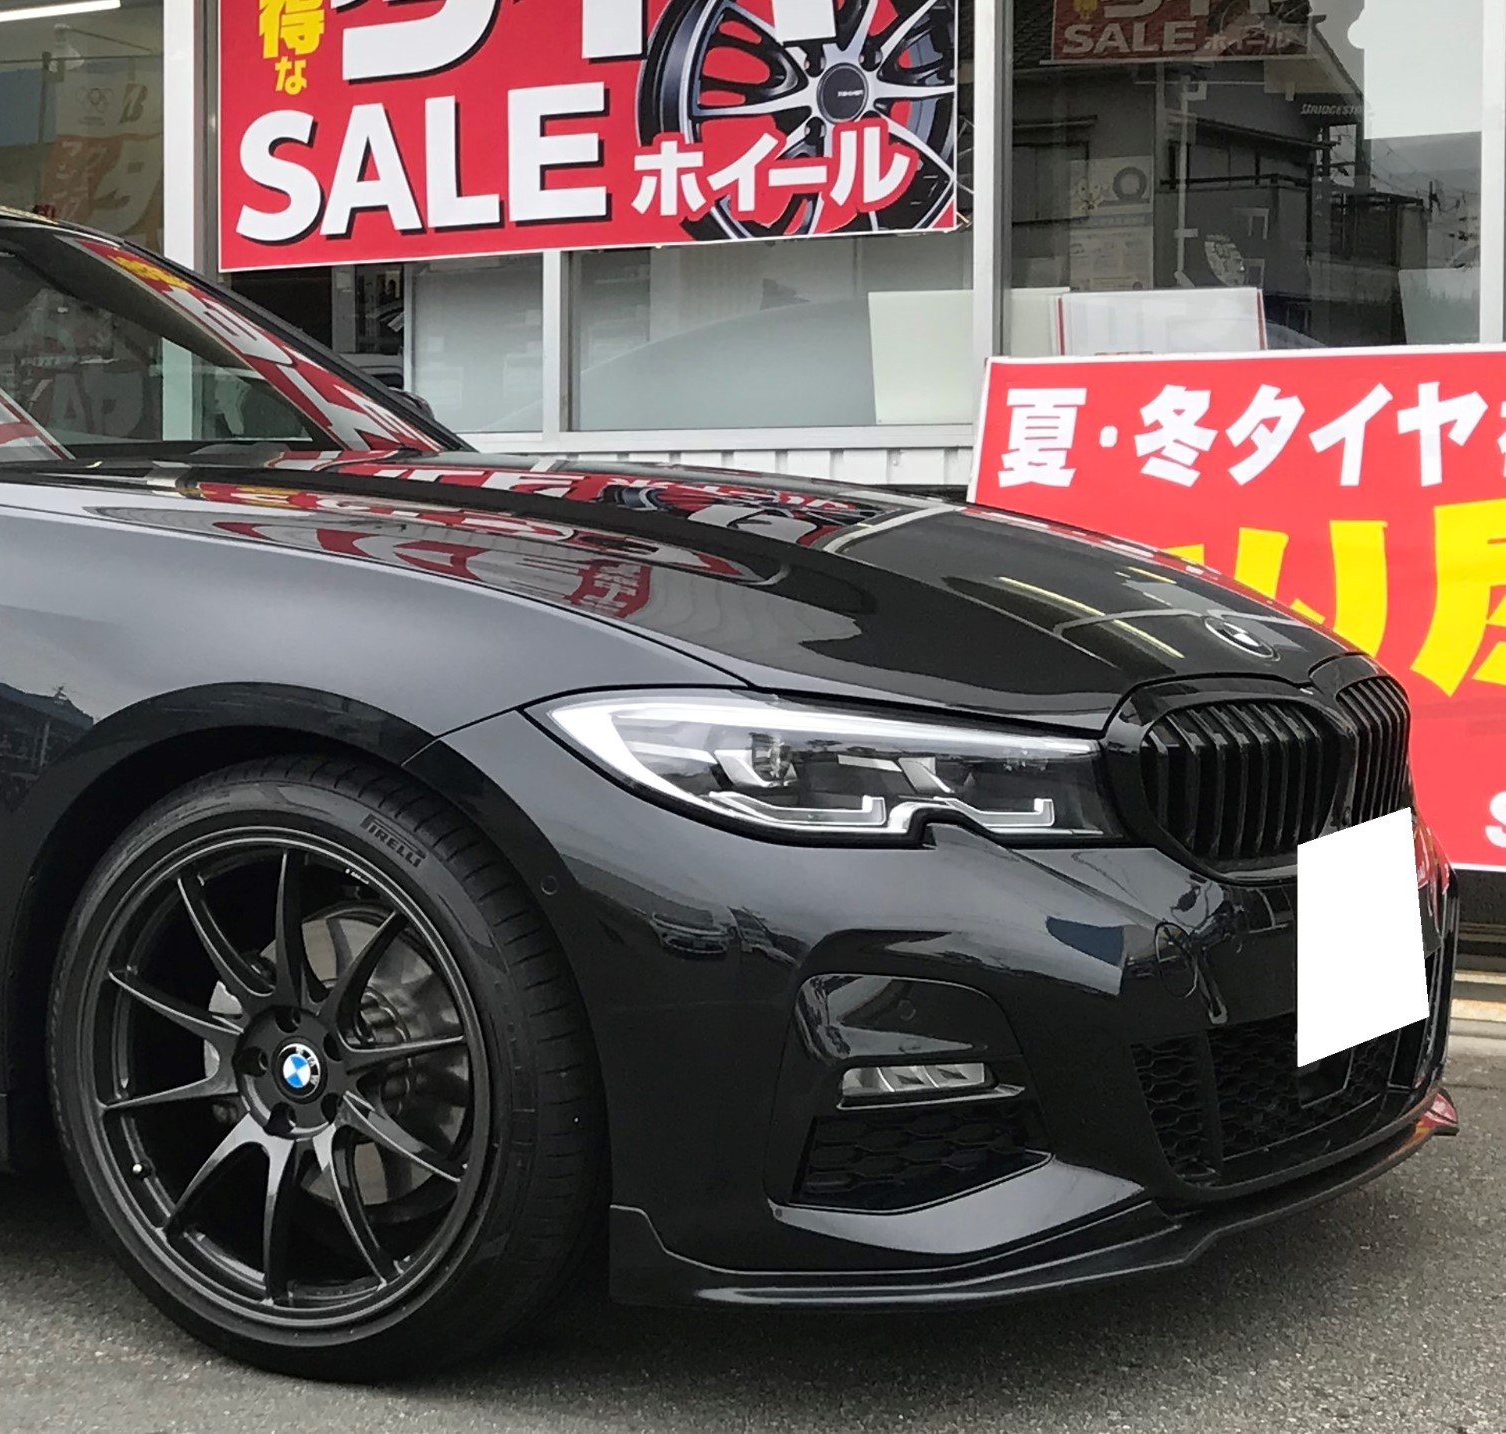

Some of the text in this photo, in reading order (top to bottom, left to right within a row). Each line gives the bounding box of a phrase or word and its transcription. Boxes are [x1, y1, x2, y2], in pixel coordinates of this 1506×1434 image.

[1062, 20, 1197, 53] SALE
[235, 80, 613, 243] SALE
[631, 120, 912, 216] ホイール
[998, 382, 1506, 488] 夏・冬タイヤ
[360, 813, 427, 868] PIRELLI
